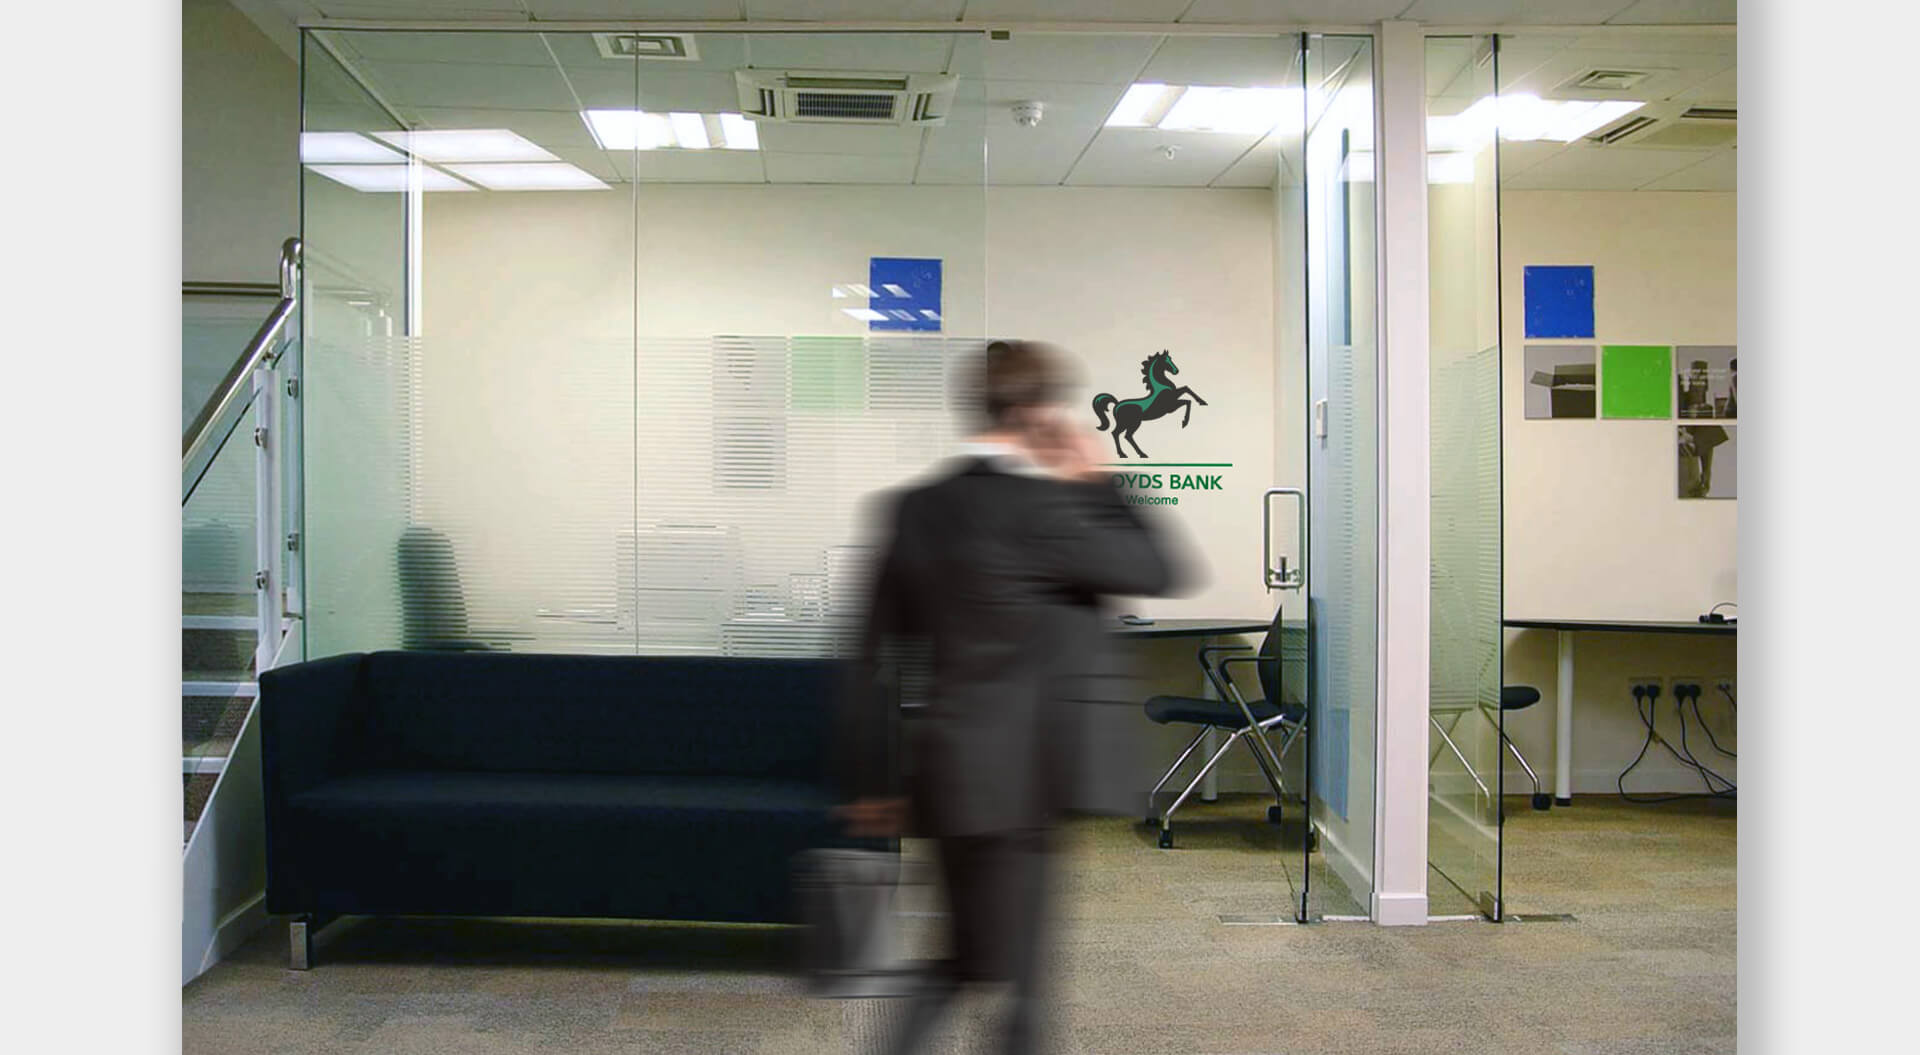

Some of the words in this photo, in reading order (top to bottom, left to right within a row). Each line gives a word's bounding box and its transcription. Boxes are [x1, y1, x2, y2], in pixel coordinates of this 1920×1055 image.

[1111, 473, 1163, 489] OYDS
[1169, 474, 1224, 490] BANK
[1126, 494, 1179, 505] Welcome
